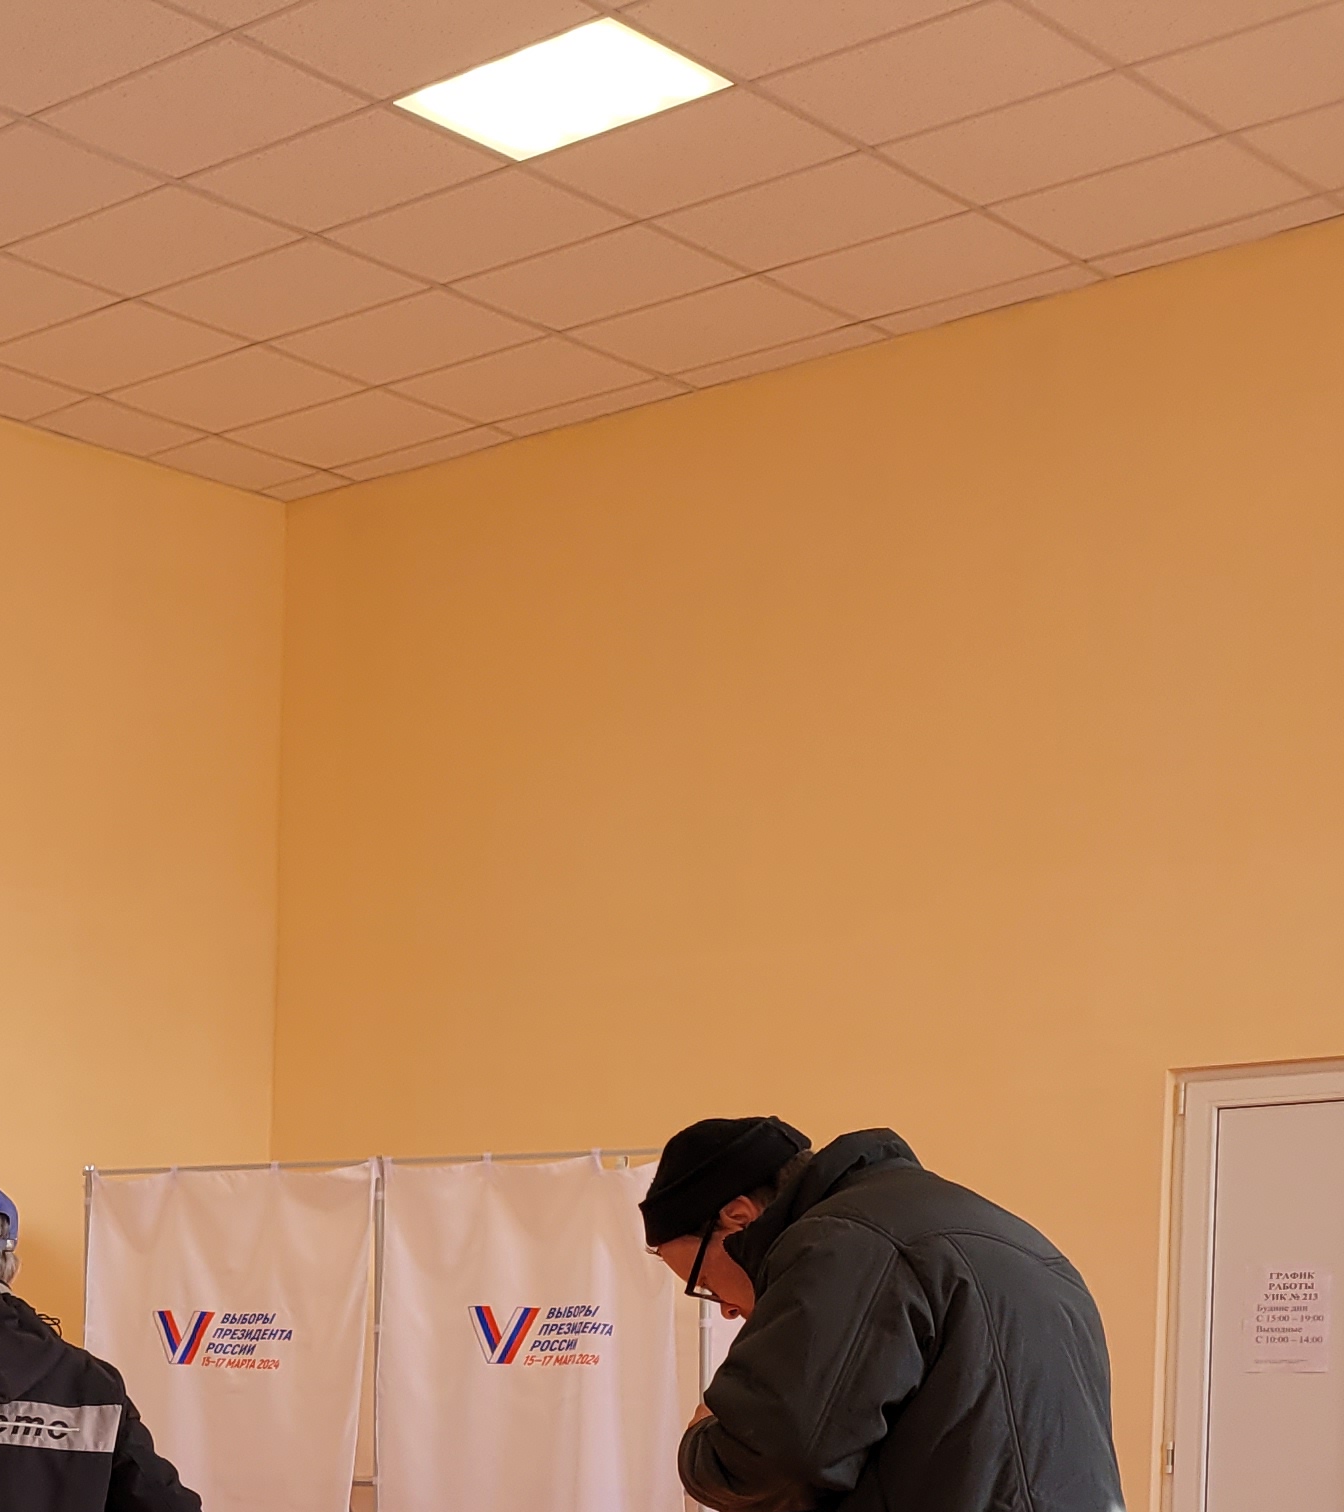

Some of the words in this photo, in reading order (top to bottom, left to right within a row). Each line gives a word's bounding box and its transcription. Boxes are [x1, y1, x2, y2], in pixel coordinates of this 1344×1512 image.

[1269, 1271, 1315, 1279] ГРАФИК
[1268, 1282, 1315, 1291] РАБОТЫ
[1264, 1293, 1287, 1301] УИК
[546, 1305, 600, 1320] ВЫБОРЫ
[220, 1313, 276, 1325] ВЫБОРЫ
[537, 1321, 613, 1336] ПРЕЗИДЕНТА
[212, 1328, 293, 1341] ПРЕЗИДЕНТА
[205, 1342, 257, 1356] РОССИИ
[226, 1358, 255, 1369] МАРТА
[257, 1359, 280, 1369] 2024
[575, 1354, 600, 1365] 2024
